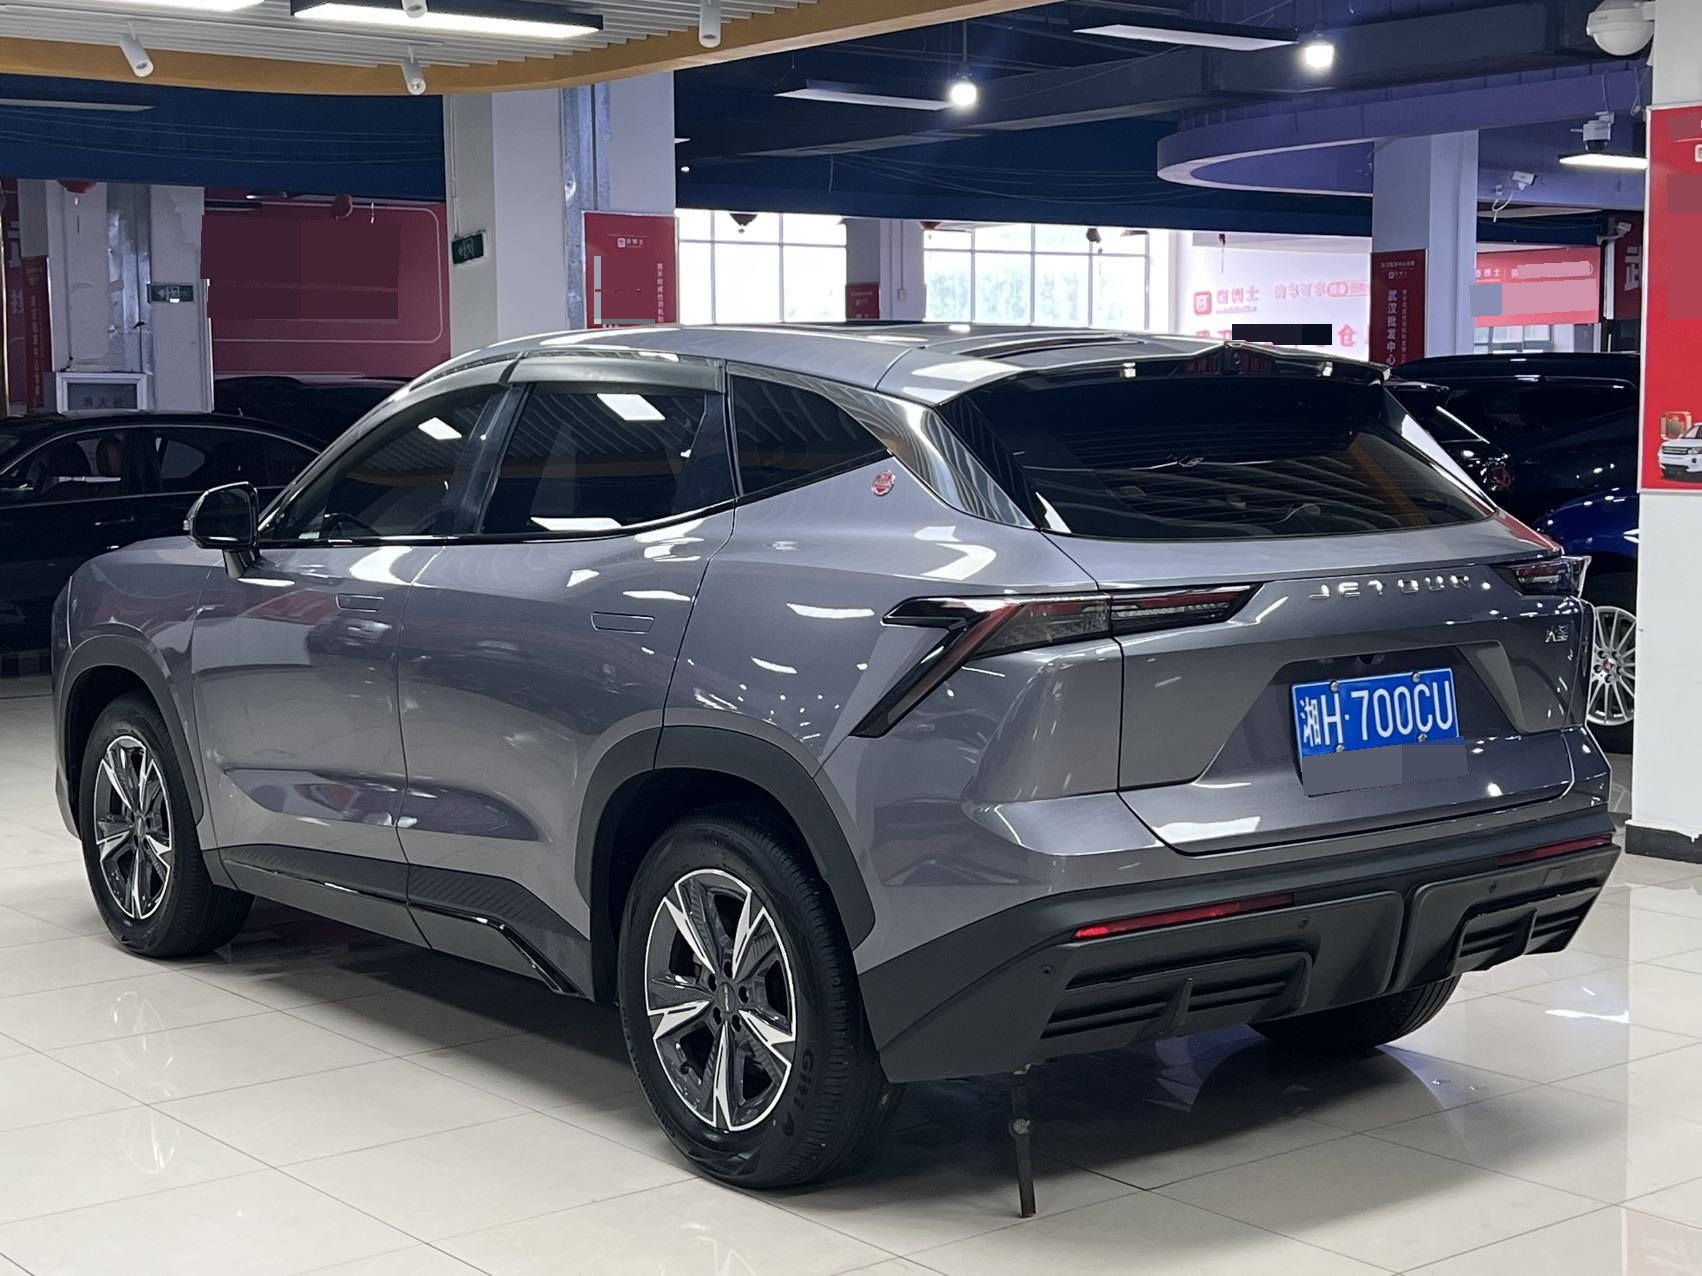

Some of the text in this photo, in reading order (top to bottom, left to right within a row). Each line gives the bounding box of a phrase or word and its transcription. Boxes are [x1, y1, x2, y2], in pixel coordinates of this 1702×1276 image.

[1386, 289, 1398, 367] 武汉批发中心
